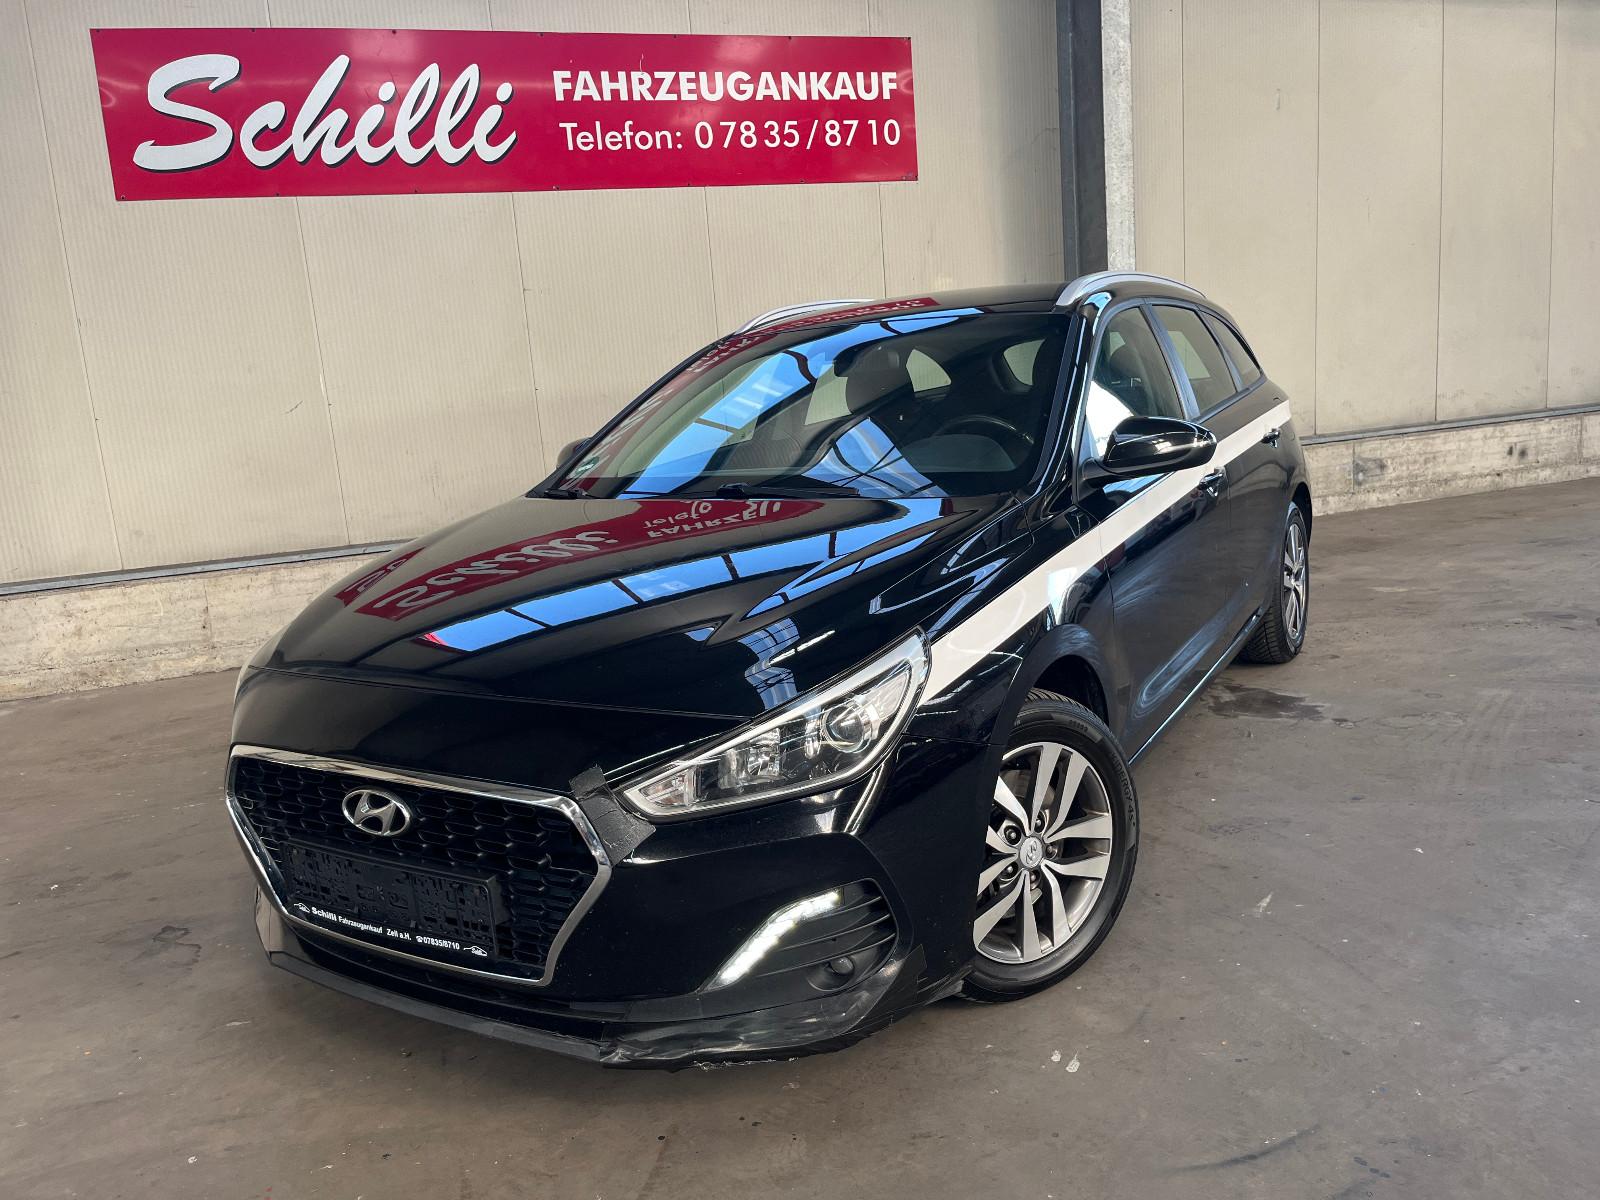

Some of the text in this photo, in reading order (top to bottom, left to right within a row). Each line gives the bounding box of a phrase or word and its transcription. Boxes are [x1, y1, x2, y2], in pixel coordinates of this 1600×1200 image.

[552, 70, 898, 102] FAHRZEUGANKAUF
[132, 53, 517, 173] Schilli
[558, 120, 683, 151] Telefon:
[311, 906, 337, 922] Schilli
